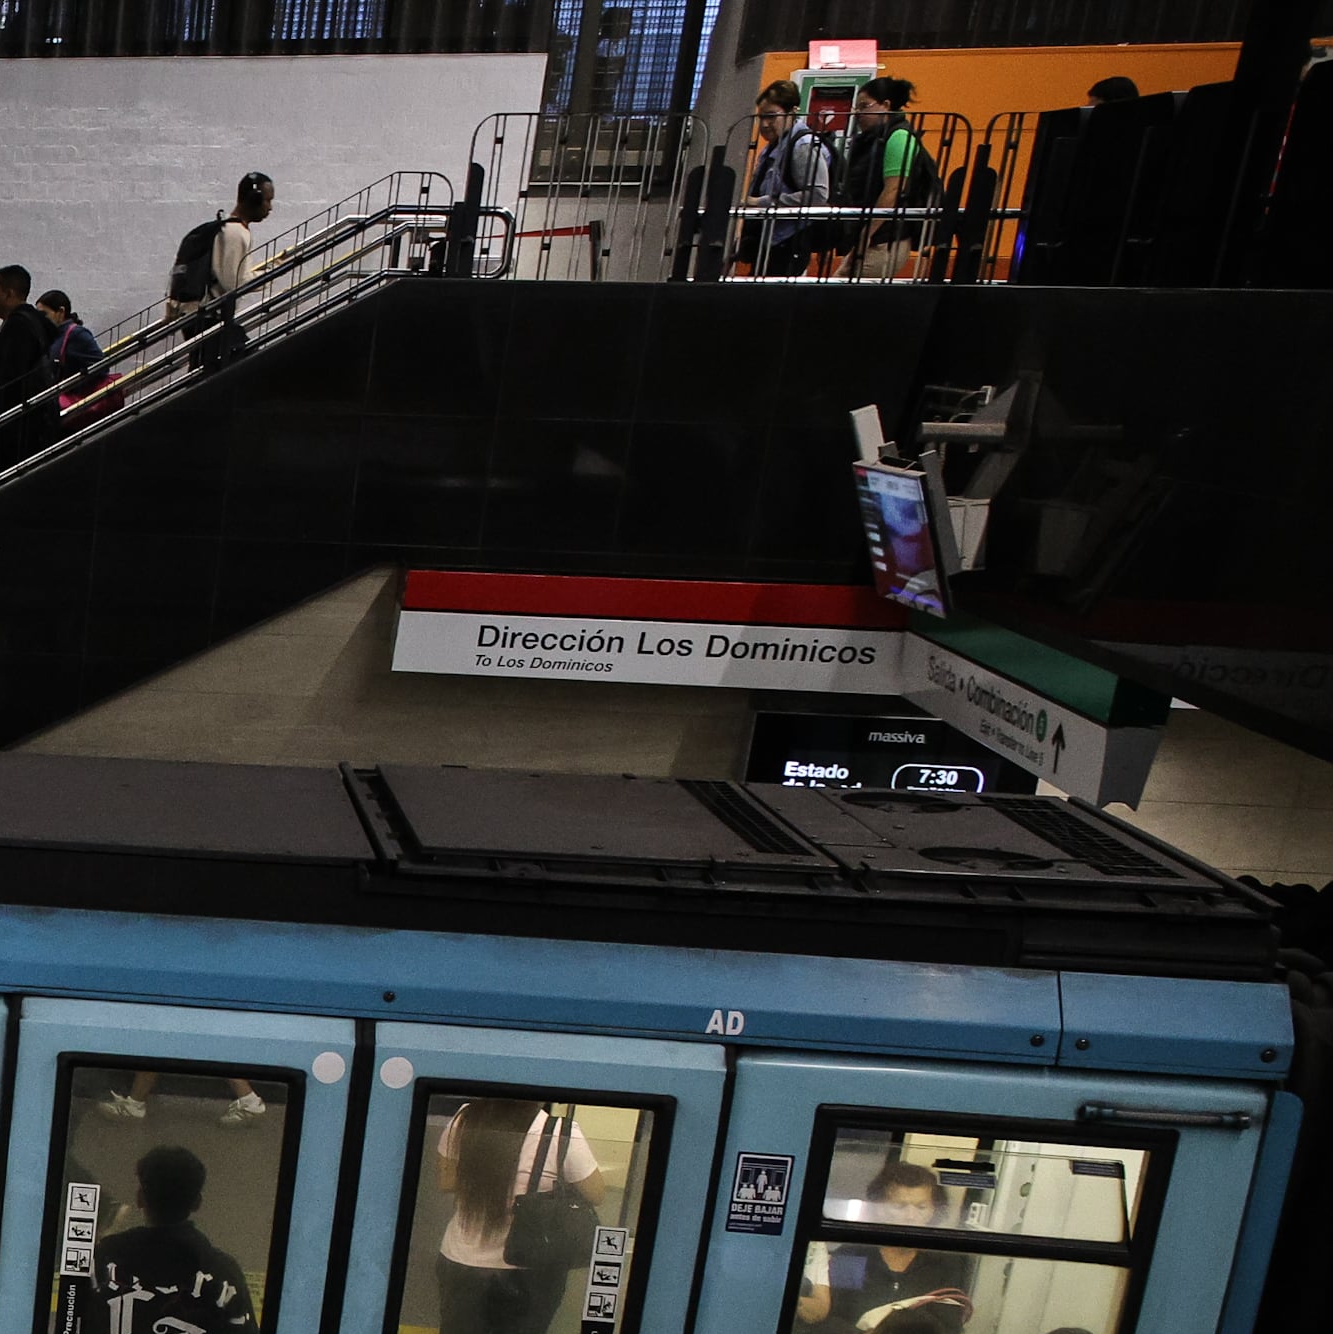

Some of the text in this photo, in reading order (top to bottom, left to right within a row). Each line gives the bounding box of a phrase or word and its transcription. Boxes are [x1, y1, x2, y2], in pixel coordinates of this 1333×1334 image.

[476, 624, 876, 665] Dirección Los Dominicos
[475, 654, 614, 673] To Los Dominicos
[928, 656, 956, 692] Salida
[868, 730, 926, 744] massiva
[784, 761, 849, 779] Estado
[919, 769, 958, 785] 7:30
[704, 1009, 745, 1036] AD
[731, 1202, 783, 1215] DEJE BAJAR
[729, 1213, 751, 1221] antes
[762, 1215, 782, 1223] subir
